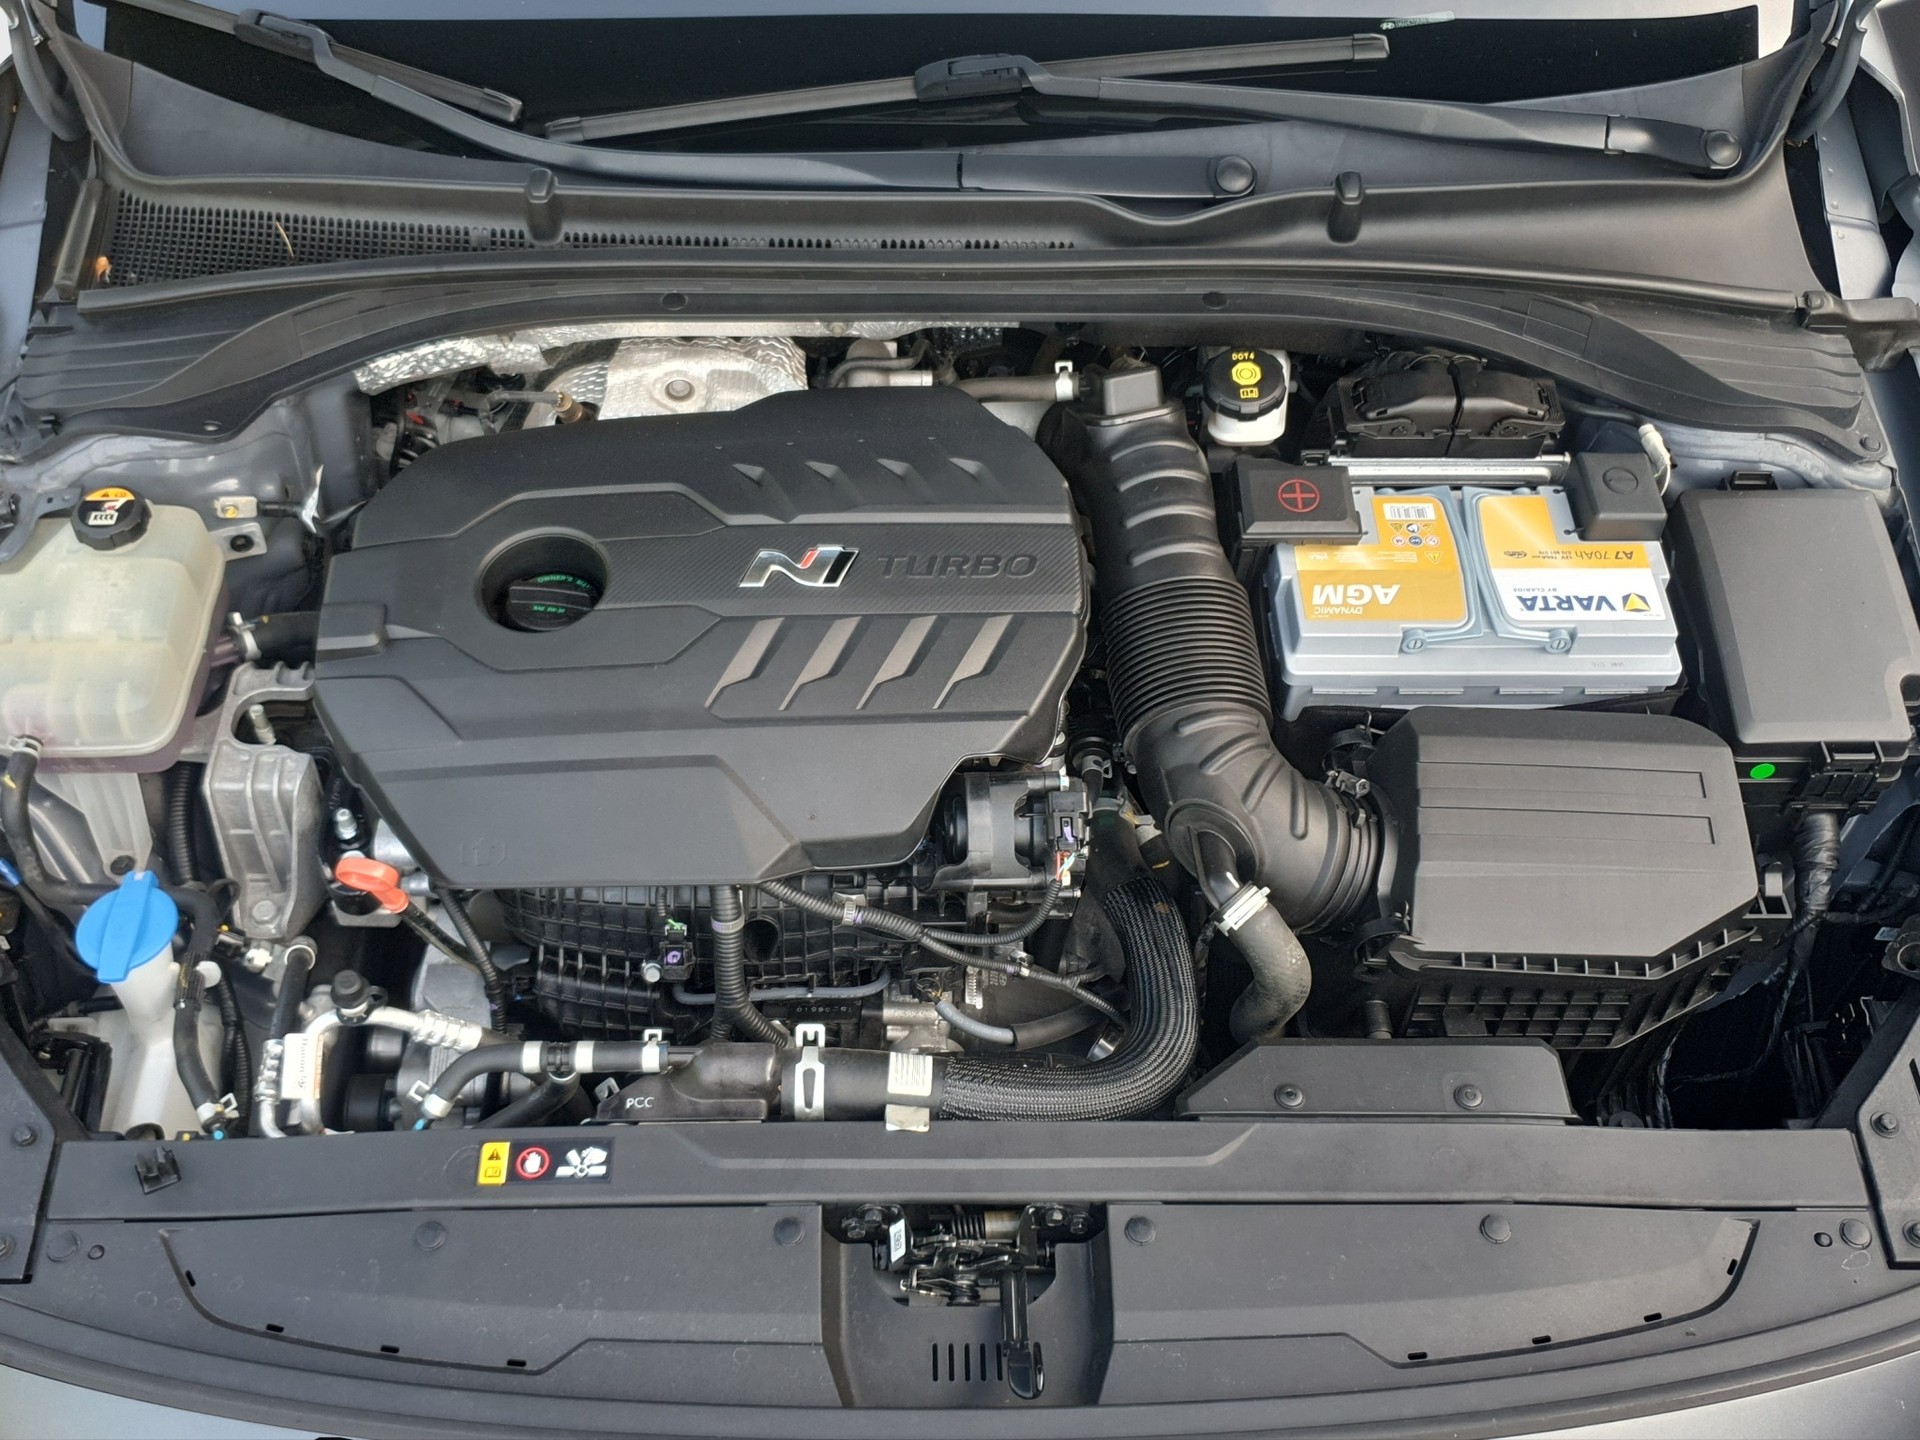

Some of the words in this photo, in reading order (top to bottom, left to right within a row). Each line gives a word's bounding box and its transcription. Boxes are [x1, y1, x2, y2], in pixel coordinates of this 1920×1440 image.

[1574, 550, 1611, 560] 70Ah
[1614, 550, 1634, 560] A7
[877, 553, 1040, 579] TURBO
[1311, 584, 1401, 605] AGM
[1313, 606, 1364, 615] DYNAMIC
[1516, 595, 1618, 612] VARTA
[625, 1096, 655, 1110] PCC
